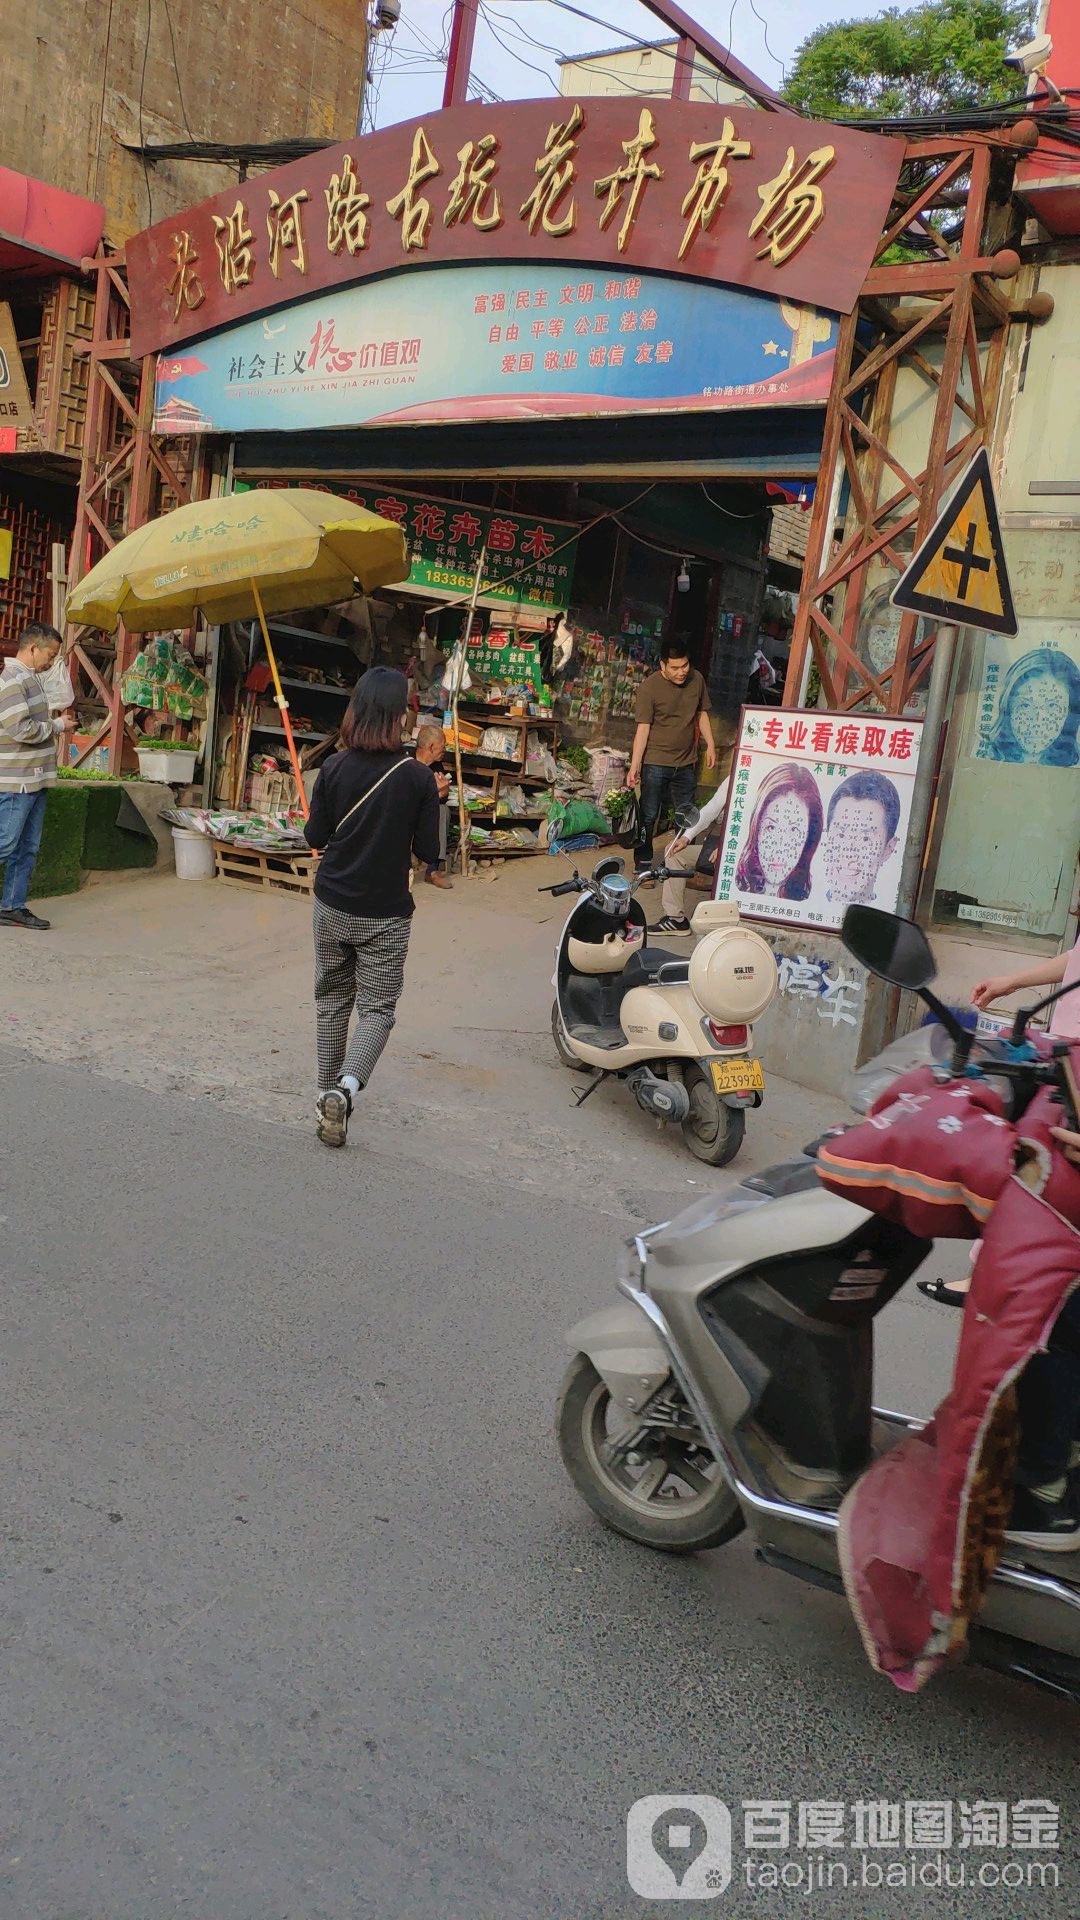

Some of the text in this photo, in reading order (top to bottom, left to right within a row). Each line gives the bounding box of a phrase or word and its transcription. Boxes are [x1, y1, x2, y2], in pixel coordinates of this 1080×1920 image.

[474, 277, 641, 314] 富强 民主 文明 和谐
[488, 308, 658, 343] 自由 平等 公正 法治
[500, 340, 674, 374] 爱国 敬业 诚信 友善
[320, 382, 337, 391] XIN
[342, 380, 357, 389] JIA
[384, 376, 415, 385] GUAN
[702, 382, 789, 397] 铭功路街道办事处
[170, 513, 266, 544] 娃哈哈
[763, 718, 914, 760] 专业看瘊取痣
[814, 763, 848, 777] 不留坑
[718, 1074, 762, 1089] 2239920
